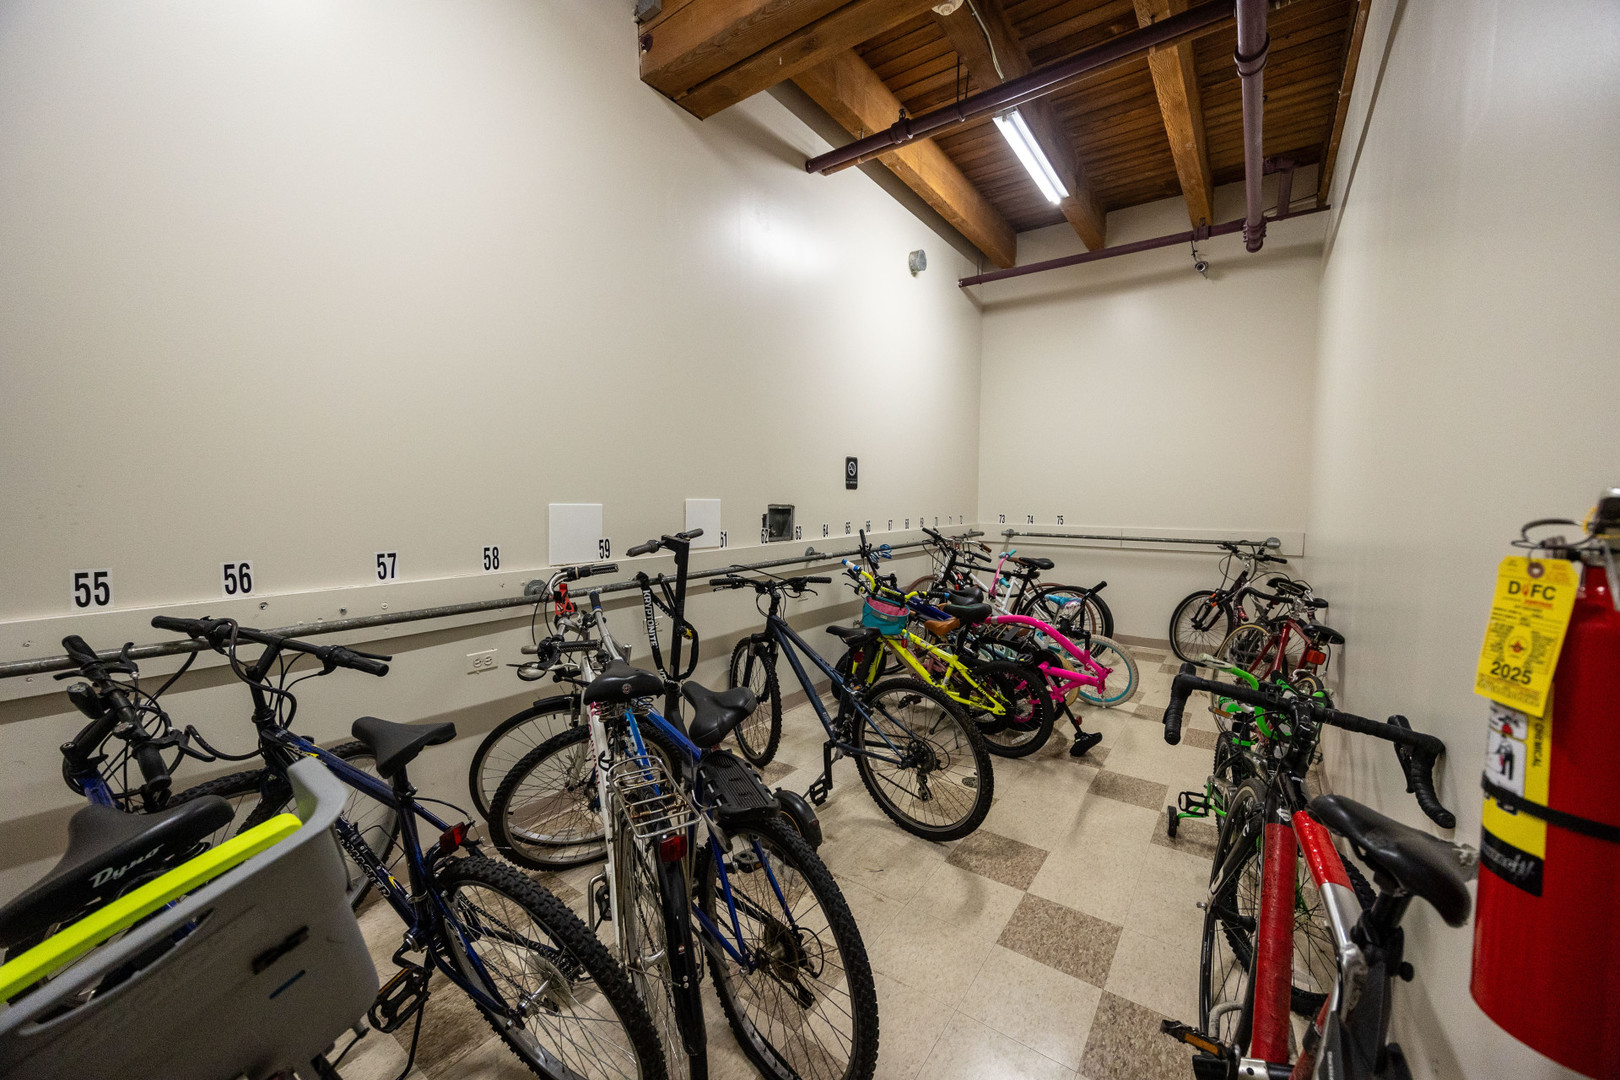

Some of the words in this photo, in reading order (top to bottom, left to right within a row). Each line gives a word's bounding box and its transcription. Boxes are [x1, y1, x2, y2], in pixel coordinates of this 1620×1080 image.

[823, 524, 829, 537] 64
[999, 514, 1006, 523] 73
[1027, 515, 1034, 524] 74
[1057, 515, 1064, 525] 75
[760, 528, 768, 544] 62
[483, 546, 500, 571] 58
[598, 538, 611, 560] 59
[376, 552, 397, 580] 57
[74, 571, 110, 608] 55
[223, 562, 252, 595] 56
[642, 589, 659, 647] KRYPTONITE
[1490, 661, 1532, 685] 2025
[88, 843, 166, 888] Dyno
